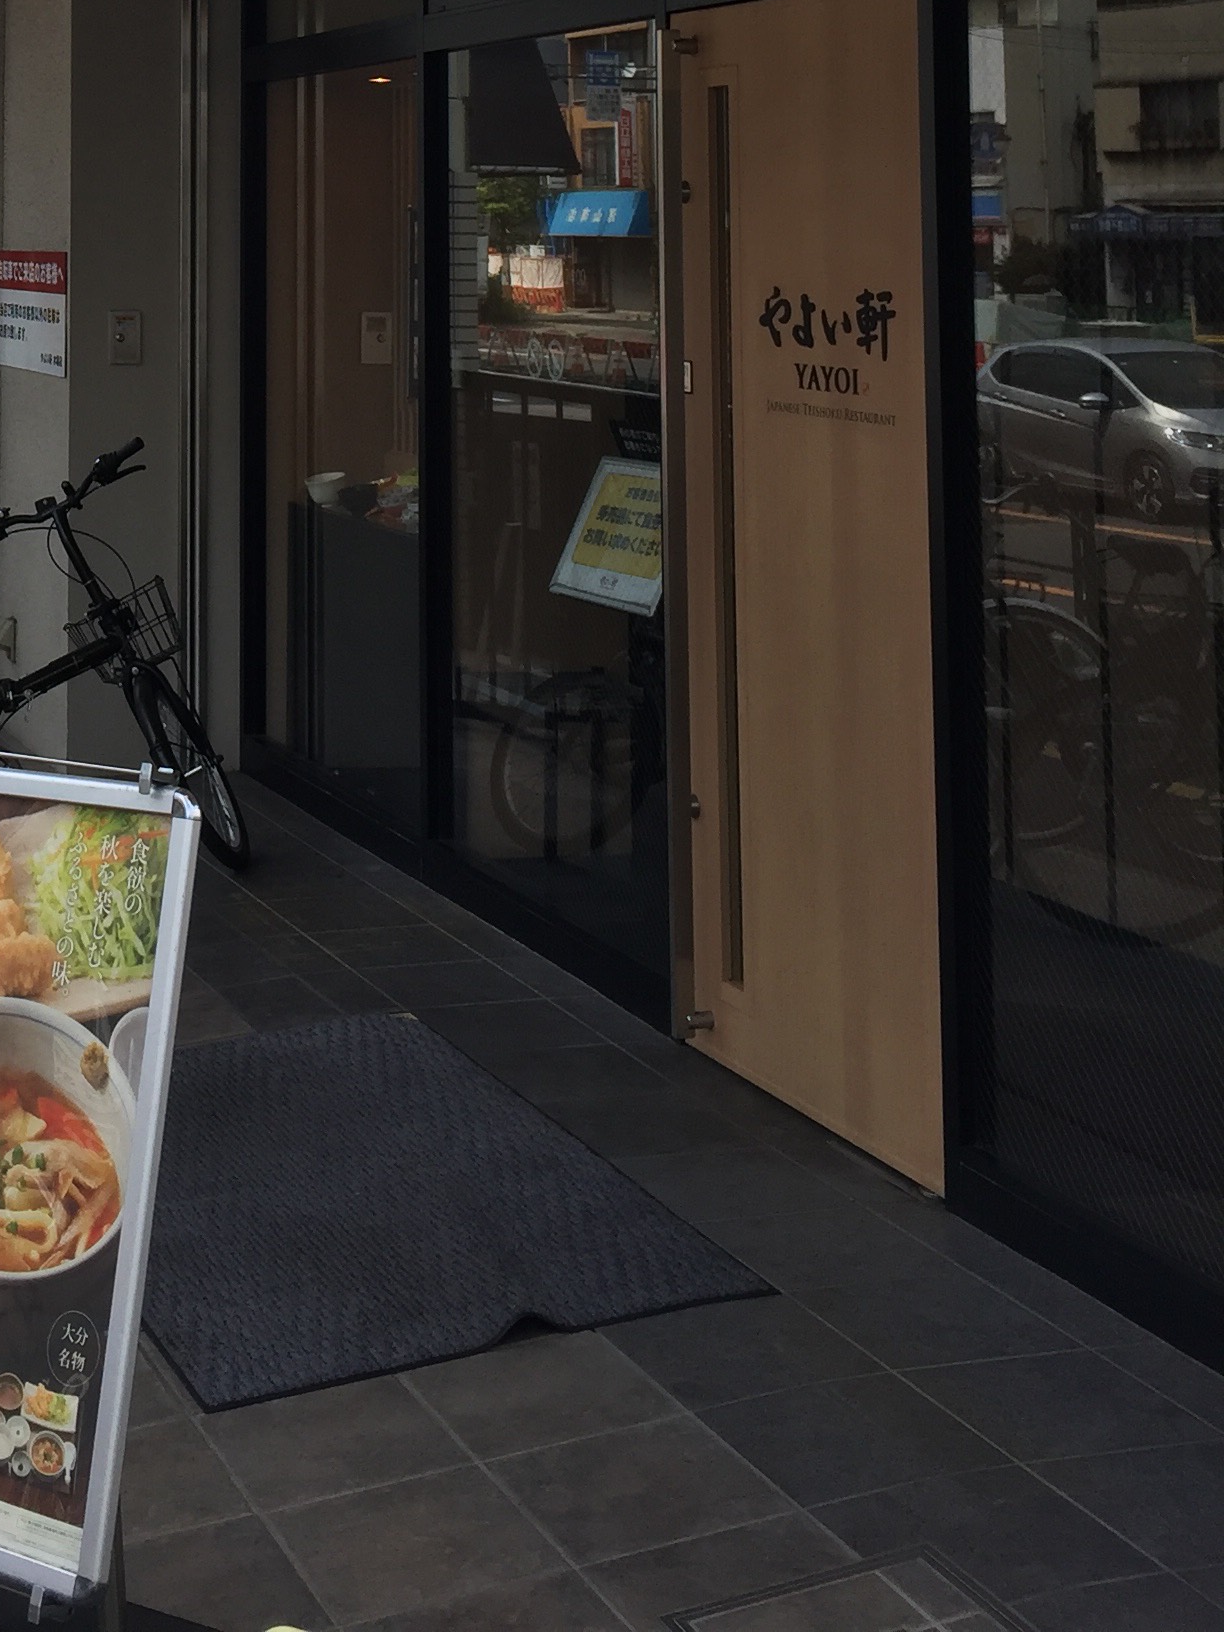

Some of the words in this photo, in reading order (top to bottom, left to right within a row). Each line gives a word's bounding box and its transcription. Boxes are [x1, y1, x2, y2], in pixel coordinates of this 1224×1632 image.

[759, 285, 897, 362] やよい軒
[794, 362, 860, 396] YAYOI
[766, 399, 801, 414] JAPANESE
[844, 408, 896, 427] RESTAURANT
[124, 837, 150, 916] 食欲の
[51, 831, 88, 997] ふるさとの味。
[60, 1322, 89, 1347] 大分
[58, 1347, 86, 1373] 名物
